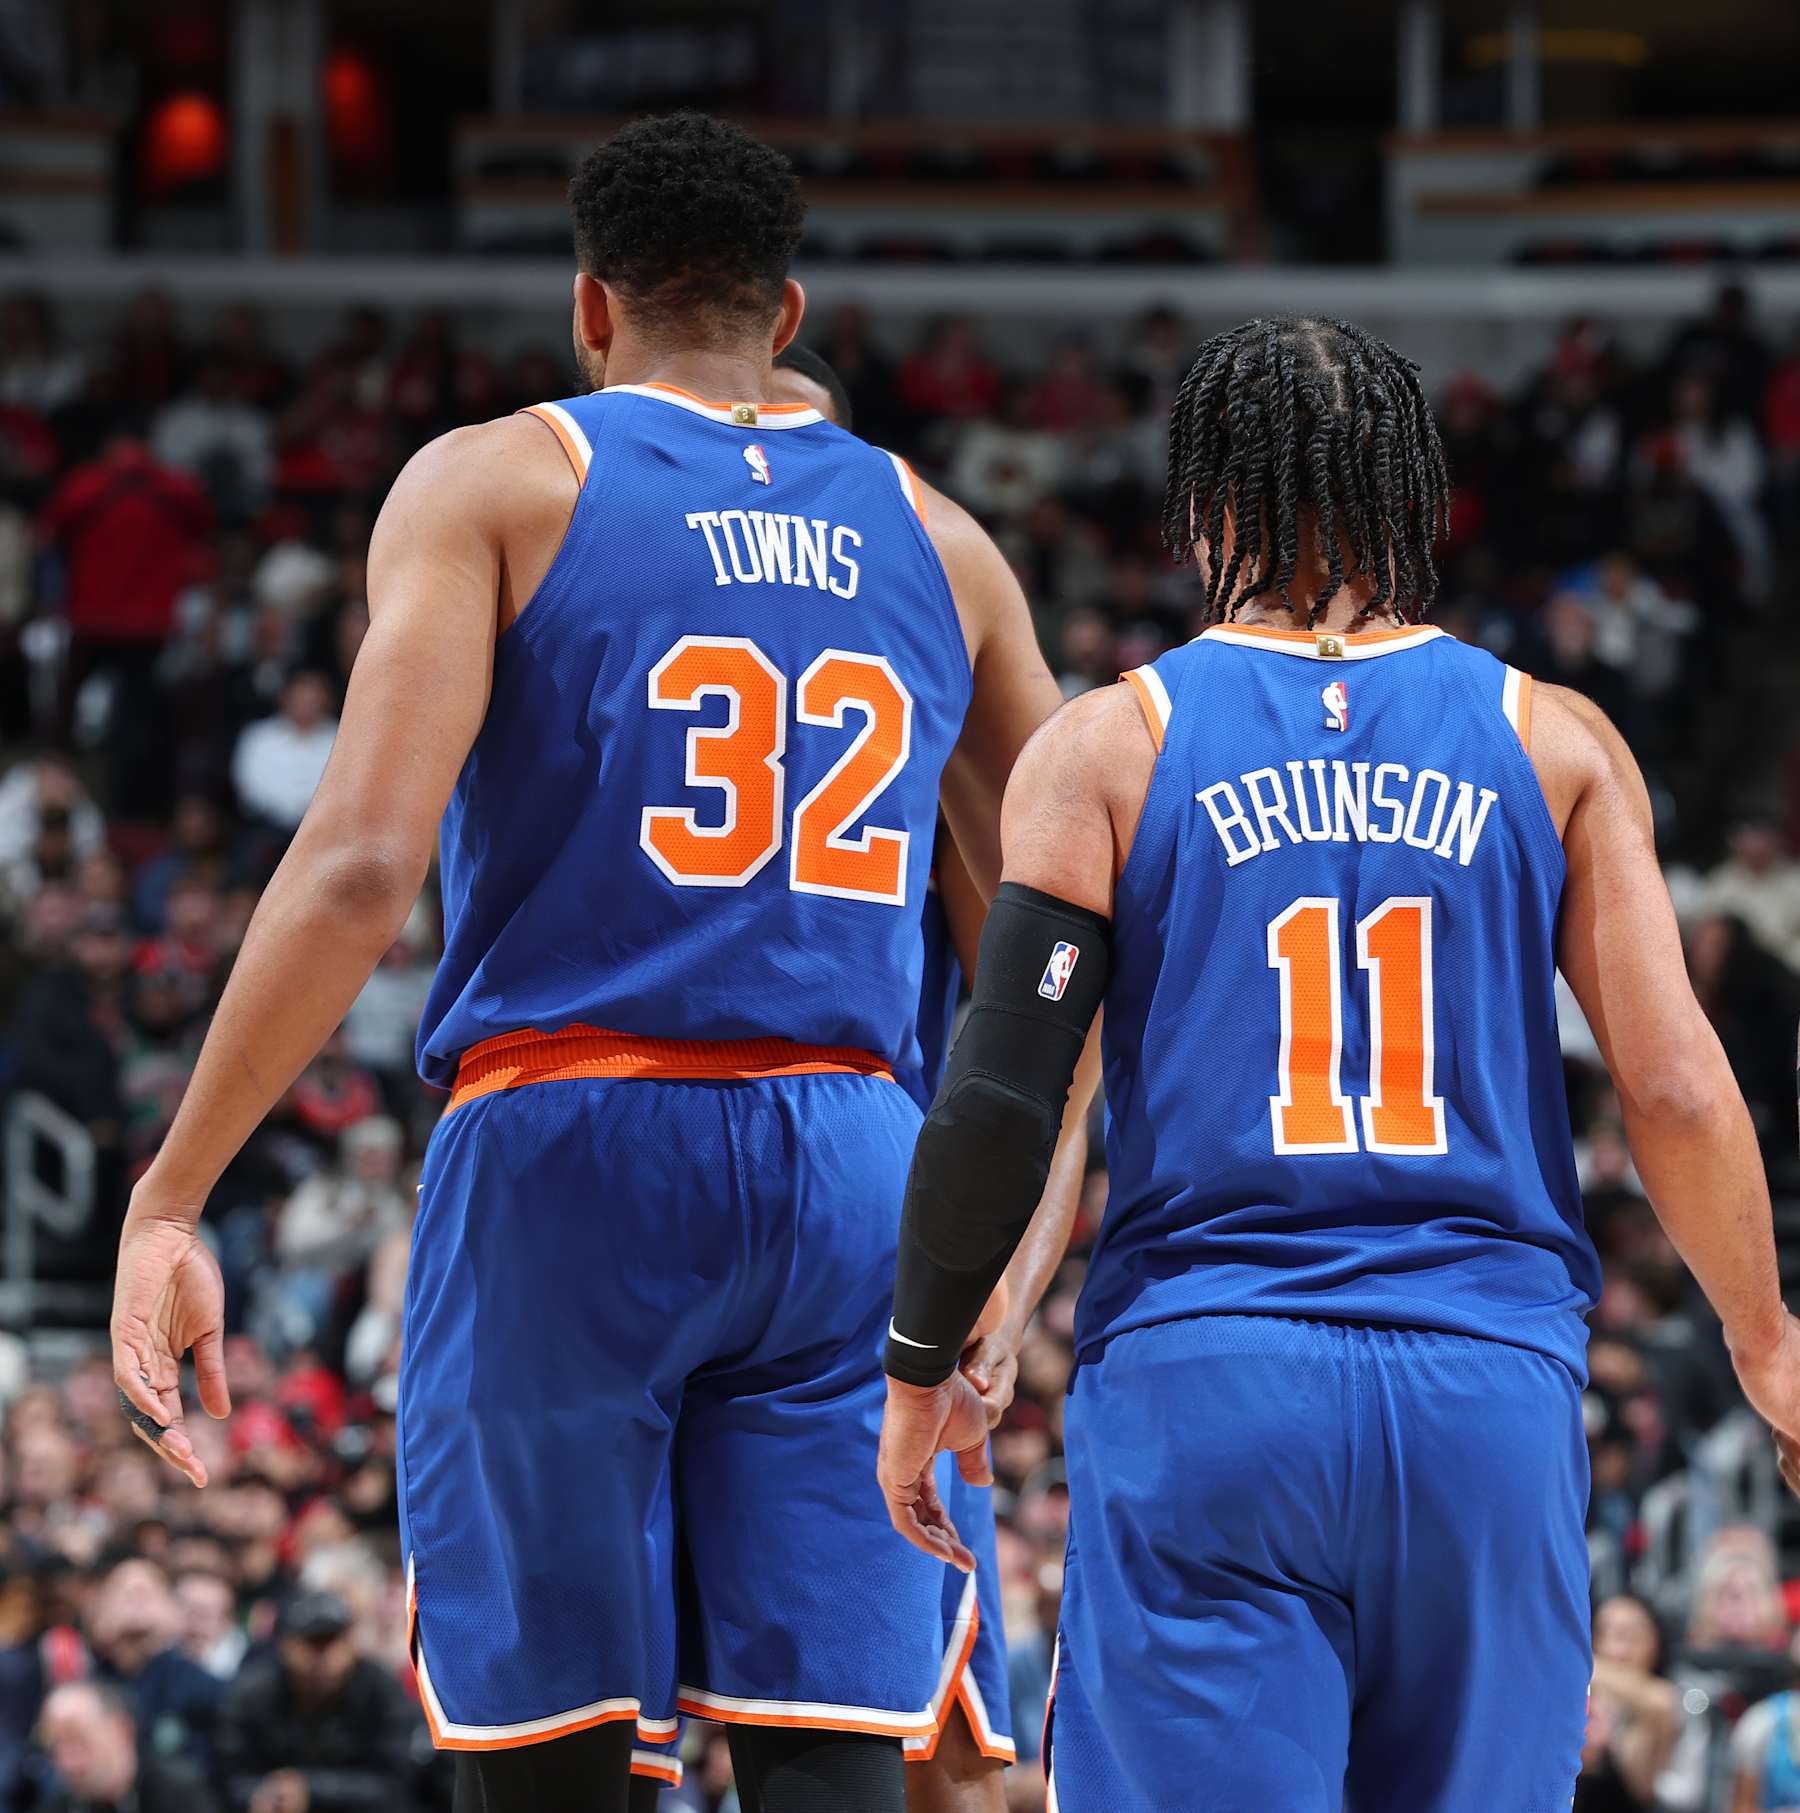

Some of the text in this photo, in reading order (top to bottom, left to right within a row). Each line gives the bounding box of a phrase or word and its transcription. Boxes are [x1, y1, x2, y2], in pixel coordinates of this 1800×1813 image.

[685, 510, 862, 600] TOWNS
[640, 634, 913, 906] 32
[1195, 759, 1498, 867] BRUNSON
[1267, 896, 1448, 1156] 11
